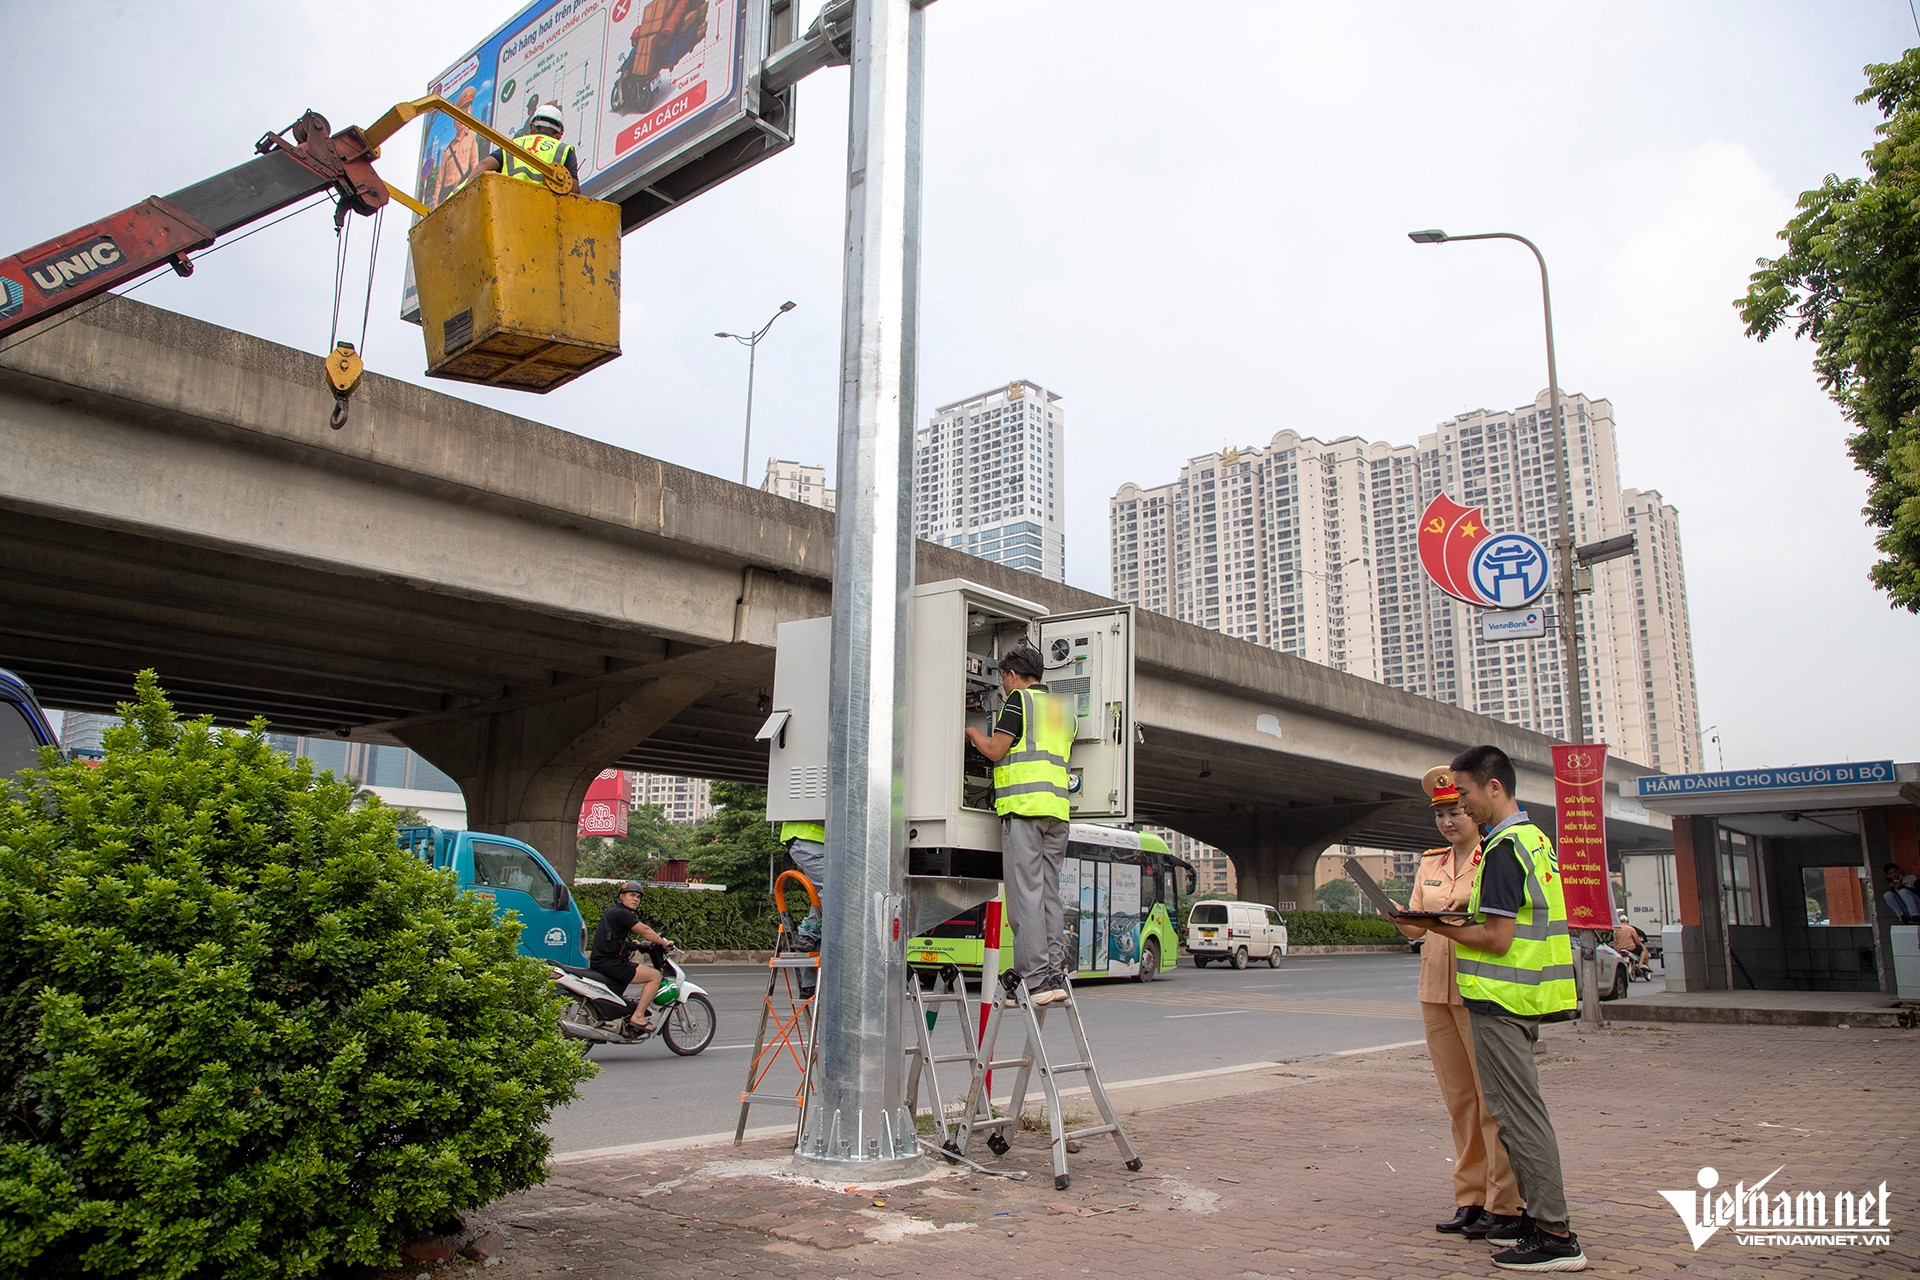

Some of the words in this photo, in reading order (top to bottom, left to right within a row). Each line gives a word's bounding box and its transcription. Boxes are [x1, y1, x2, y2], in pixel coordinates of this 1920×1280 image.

[502, 42, 518, 63] Chở
[518, 29, 537, 52] hàng
[554, 4, 572, 24] trên
[524, 41, 545, 60] Không
[546, 28, 561, 44] vượt
[562, 16, 580, 32] chiều
[678, 78, 689, 90] Quá
[690, 73, 700, 83] sau
[633, 118, 653, 140] SAI
[655, 96, 689, 126] CÁCH
[31, 241, 121, 290] UNIC
[1488, 620, 1529, 630] VietinBank
[1646, 776, 1681, 792] HẦM
[1684, 775, 1730, 790] DÀNH
[1735, 773, 1771, 787] CHO
[1776, 768, 1831, 784] NGƯỜI
[1835, 768, 1854, 780] ĐI
[1859, 763, 1886, 781] BỘ
[1578, 821, 1597, 830] TẢNG
[1560, 835, 1574, 844] CỦA
[1586, 837, 1603, 846] ĐỊNH
[1576, 849, 1586, 858] VÀ
[1562, 862, 1580, 871] PHÁT
